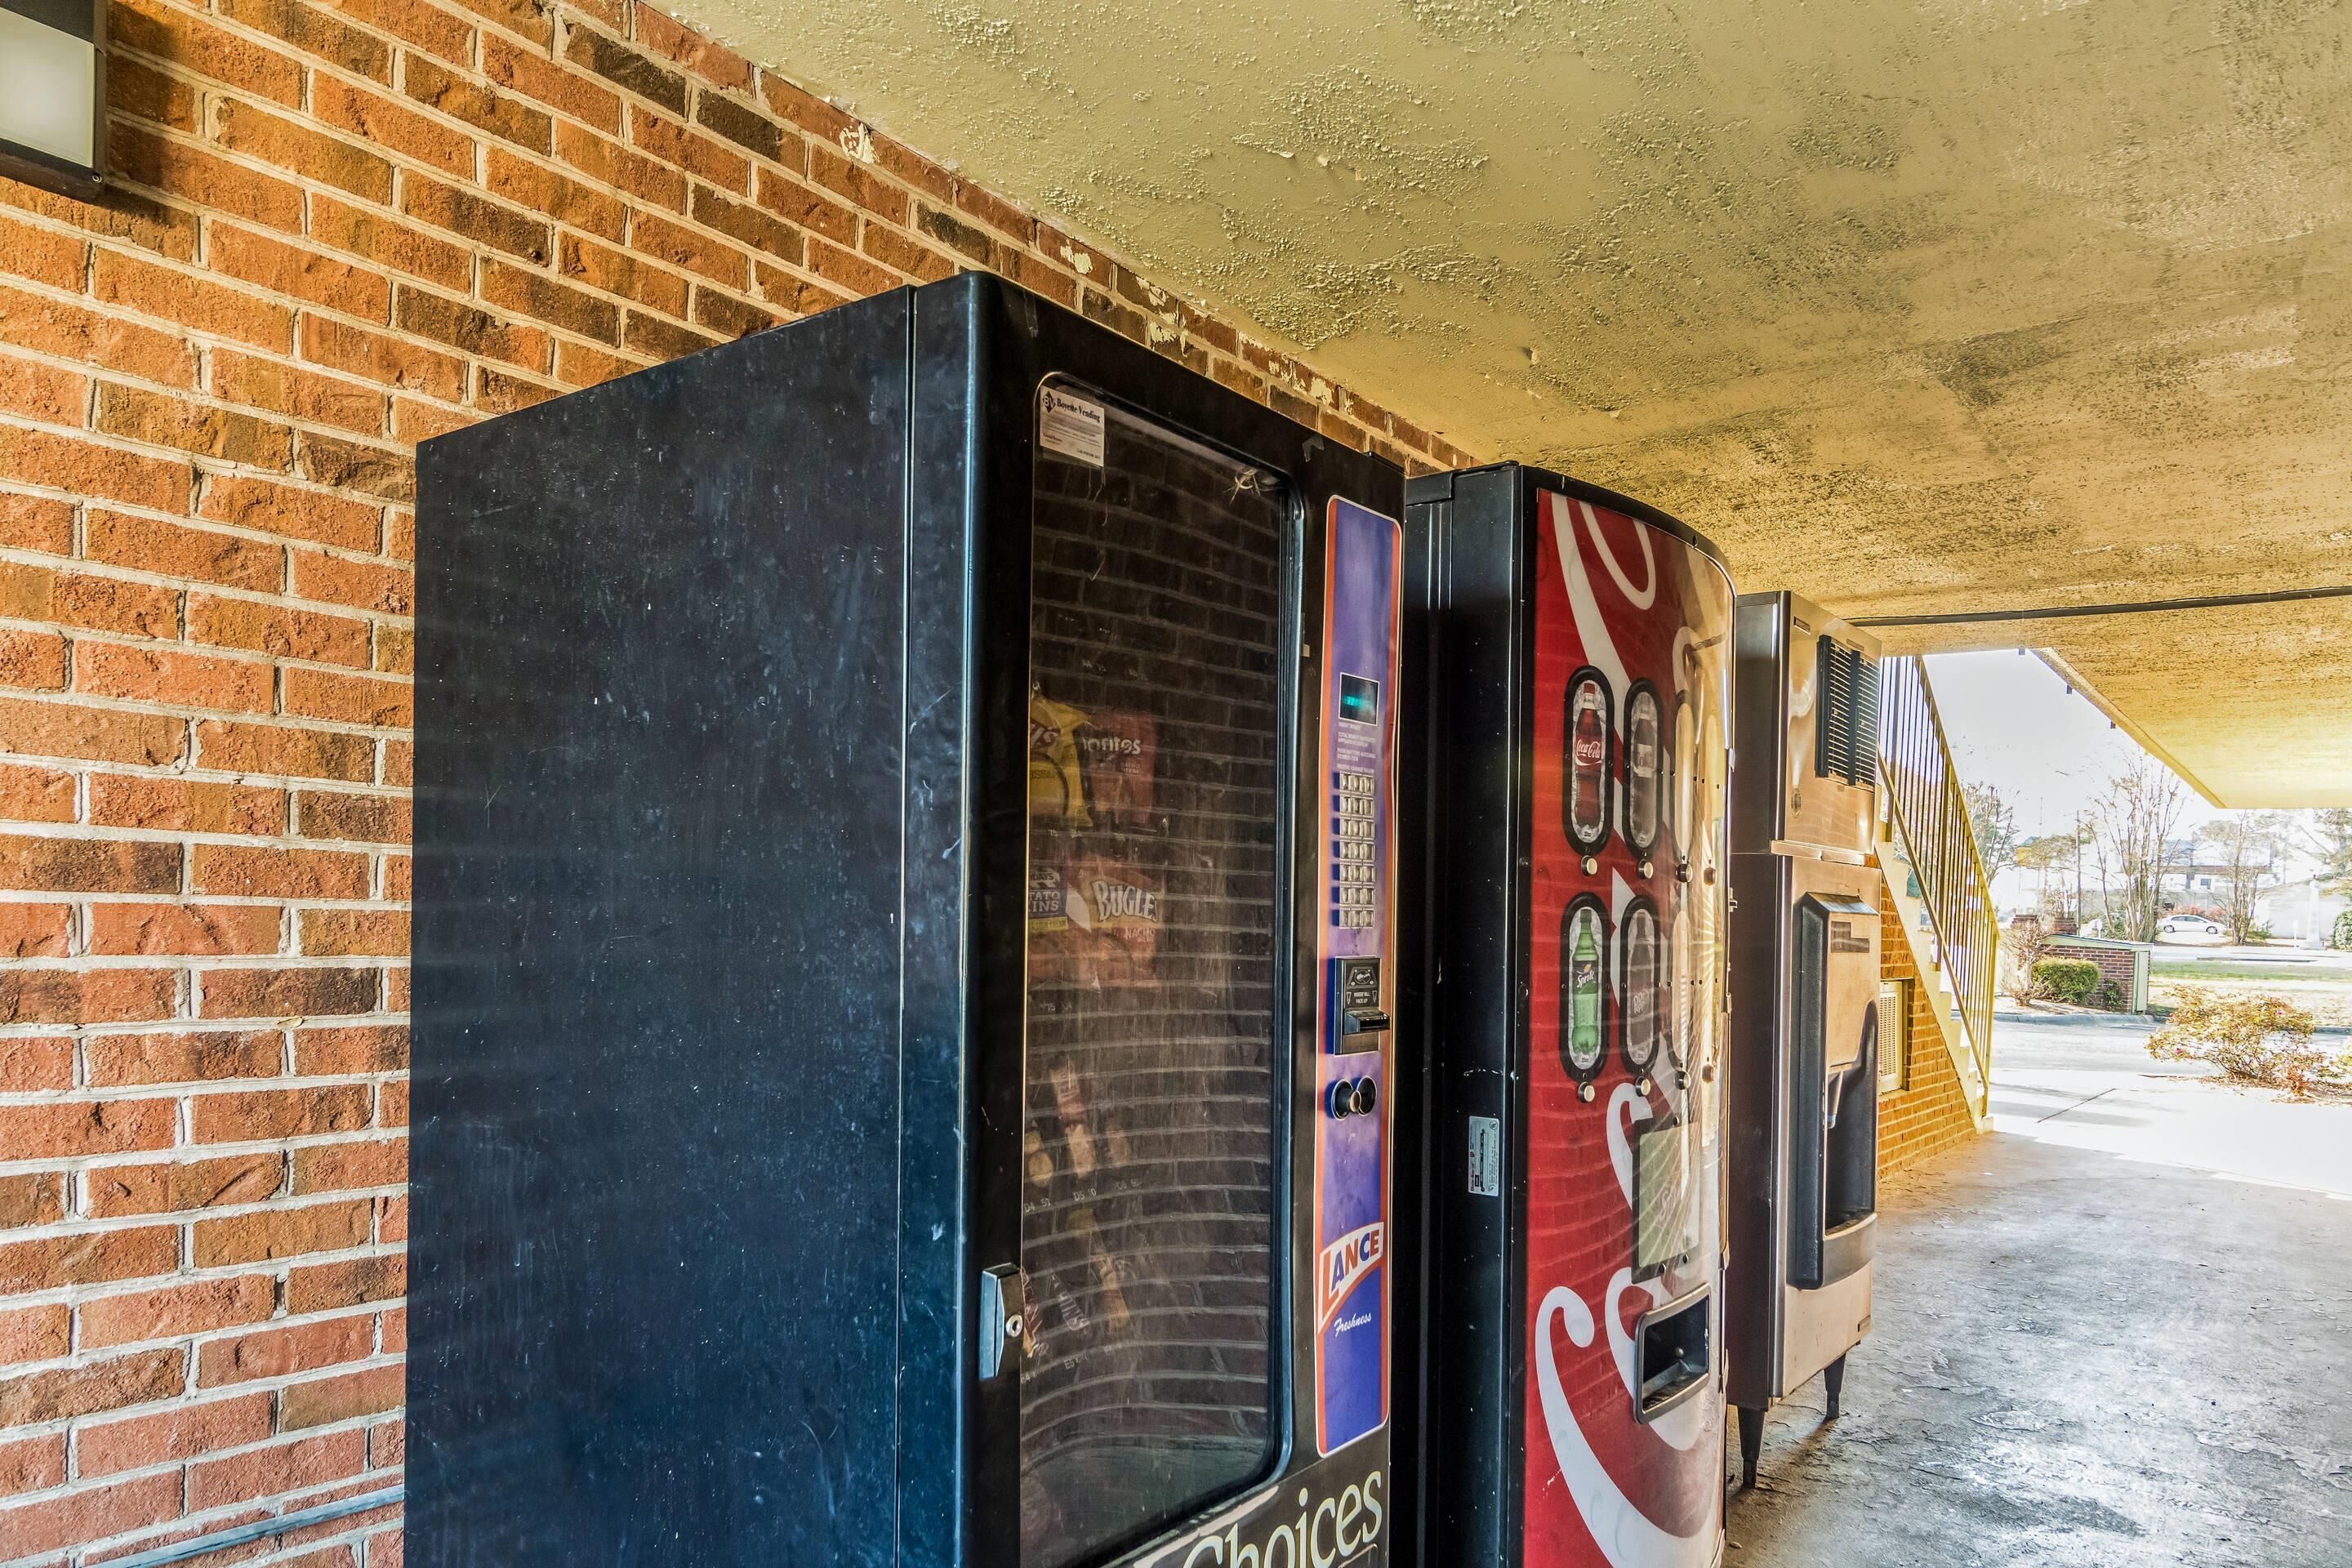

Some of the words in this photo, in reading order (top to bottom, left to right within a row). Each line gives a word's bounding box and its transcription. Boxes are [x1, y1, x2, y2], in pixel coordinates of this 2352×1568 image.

[1057, 399, 1078, 413] Boyette
[1078, 405, 1100, 423] Vending
[1030, 891, 1060, 902] TATO
[1030, 901, 1059, 913] INS
[1124, 927, 1156, 940] NACHO
[1576, 969, 1595, 988] Sprite
[1321, 1229, 1380, 1323] LANCE
[1334, 1312, 1372, 1338] Freshness
